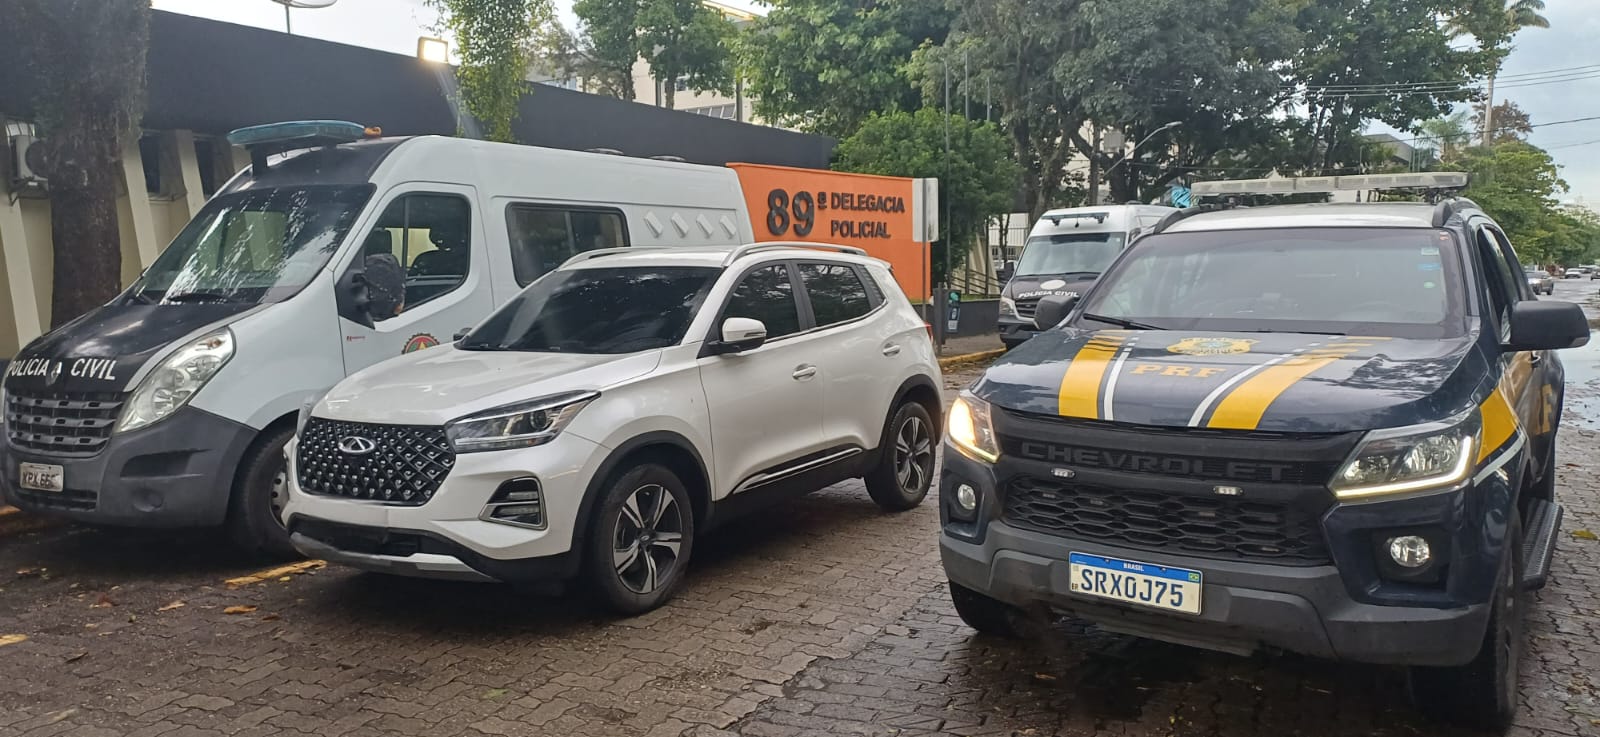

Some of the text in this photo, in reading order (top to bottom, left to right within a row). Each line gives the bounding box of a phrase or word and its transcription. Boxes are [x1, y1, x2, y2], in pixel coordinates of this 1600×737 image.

[831, 192, 905, 213] DELEGACIA
[831, 219, 891, 239] POLICIAL
[1055, 290, 1080, 298] CIVIL
[6, 354, 117, 381] POLÍCIA CIVIL
[1130, 364, 1227, 378] PRF
[1020, 441, 1293, 481] CHEVROLET
[1123, 562, 1145, 572] BRASIL
